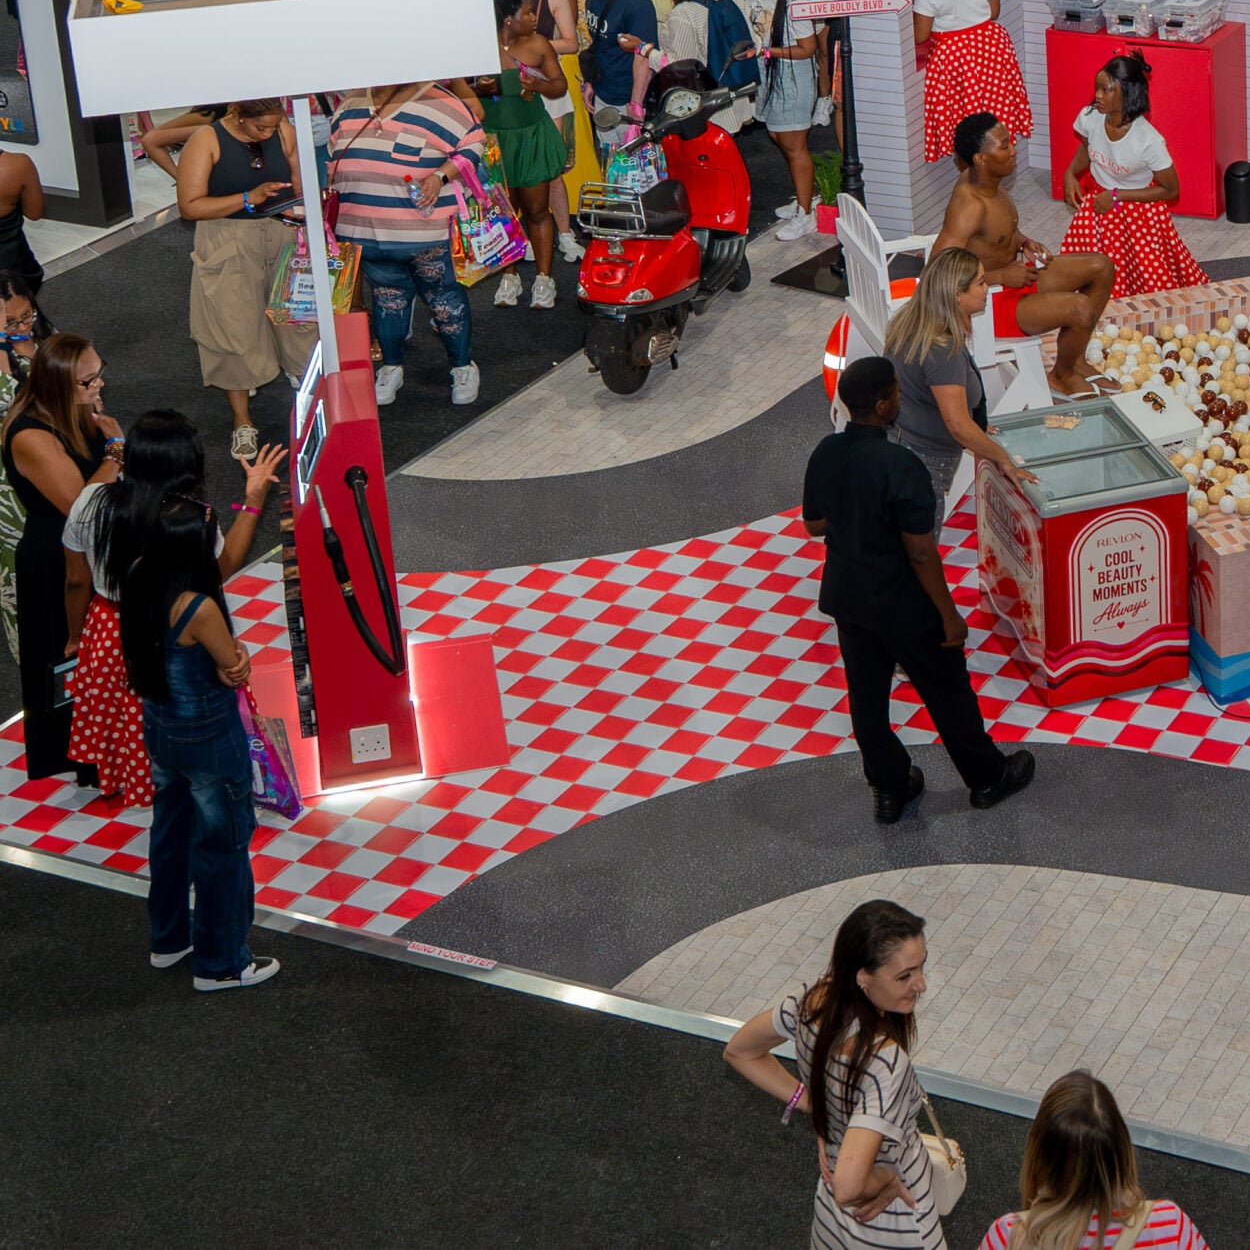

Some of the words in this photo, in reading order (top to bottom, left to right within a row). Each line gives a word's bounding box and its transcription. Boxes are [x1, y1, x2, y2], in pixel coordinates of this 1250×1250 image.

[808, 2, 828, 15] LIVE
[830, 0, 860, 13] BOLDLY
[863, 0, 883, 11] BLVD
[1096, 531, 1143, 549] REVLON
[1104, 550, 1135, 568] COOL
[1097, 564, 1143, 585] BEAUTY
[1092, 579, 1148, 602] MOMENTS
[1092, 599, 1151, 625] Always
[409, 942, 435, 953] MIND
[437, 949, 465, 961] YOUR
[467, 956, 495, 967] STEP
